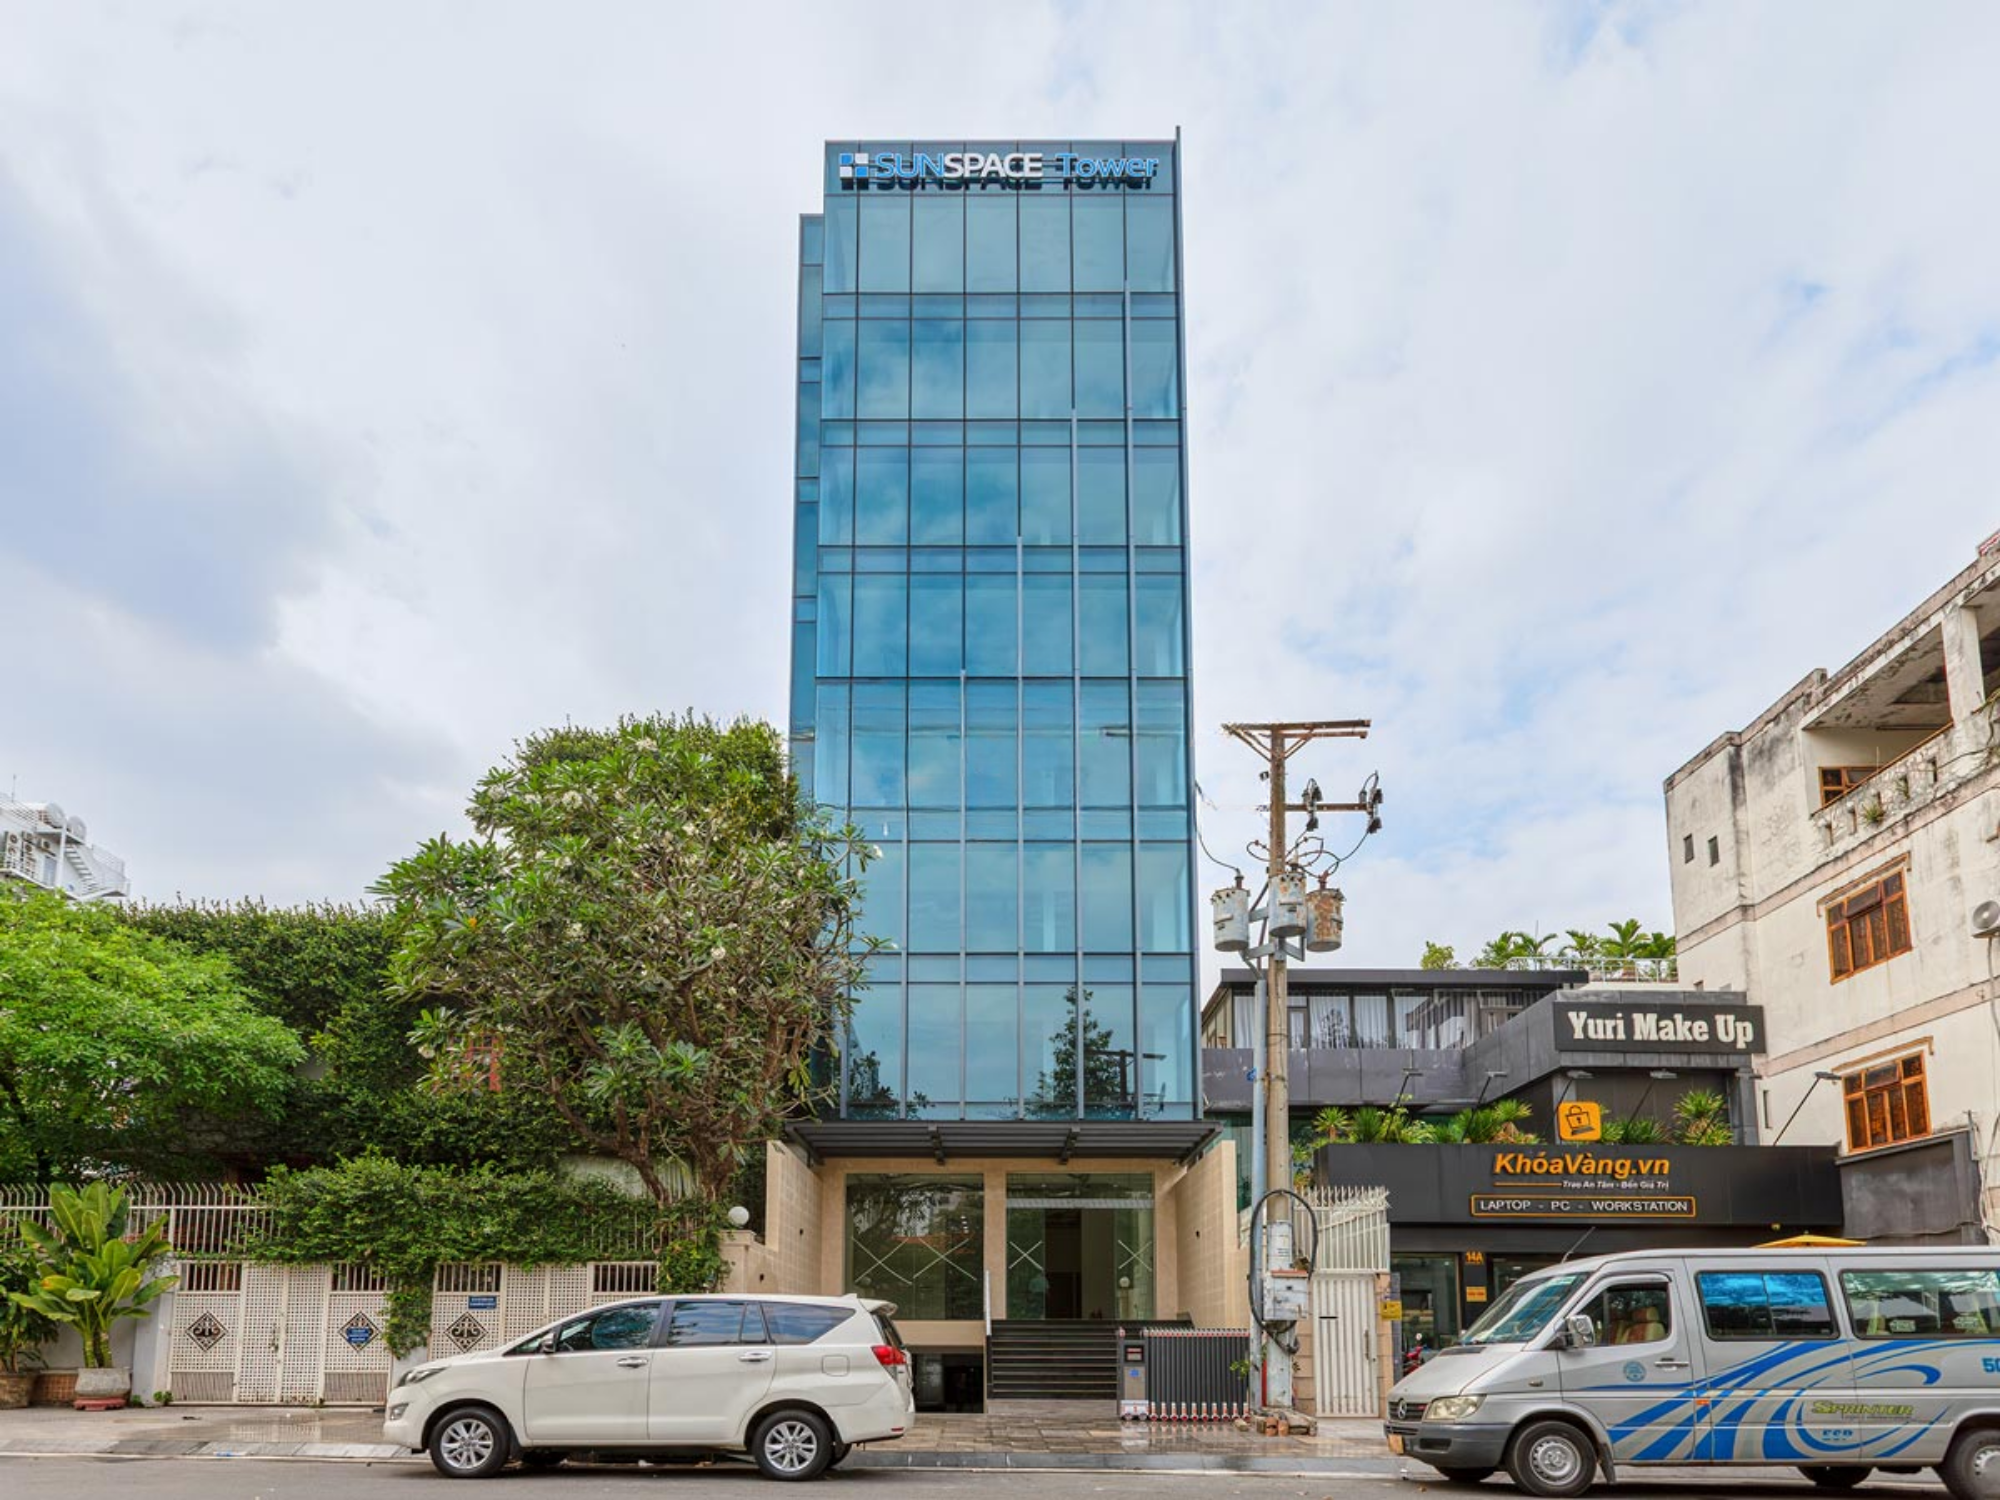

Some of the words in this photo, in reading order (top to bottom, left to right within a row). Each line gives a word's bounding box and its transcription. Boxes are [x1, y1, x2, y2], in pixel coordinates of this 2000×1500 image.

[875, 153, 1043, 178] SUNSPACE
[1054, 153, 1158, 178] Tower
[1568, 1011, 1626, 1040] Yuri
[1632, 1013, 1709, 1042] Make
[1715, 1014, 1754, 1049] Up
[1494, 1151, 1670, 1179] KhóaVàng.vn
[1480, 1200, 1531, 1211] LAPTOP
[1551, 1201, 1570, 1211] PC
[1591, 1201, 1688, 1212] WORKSTATION
